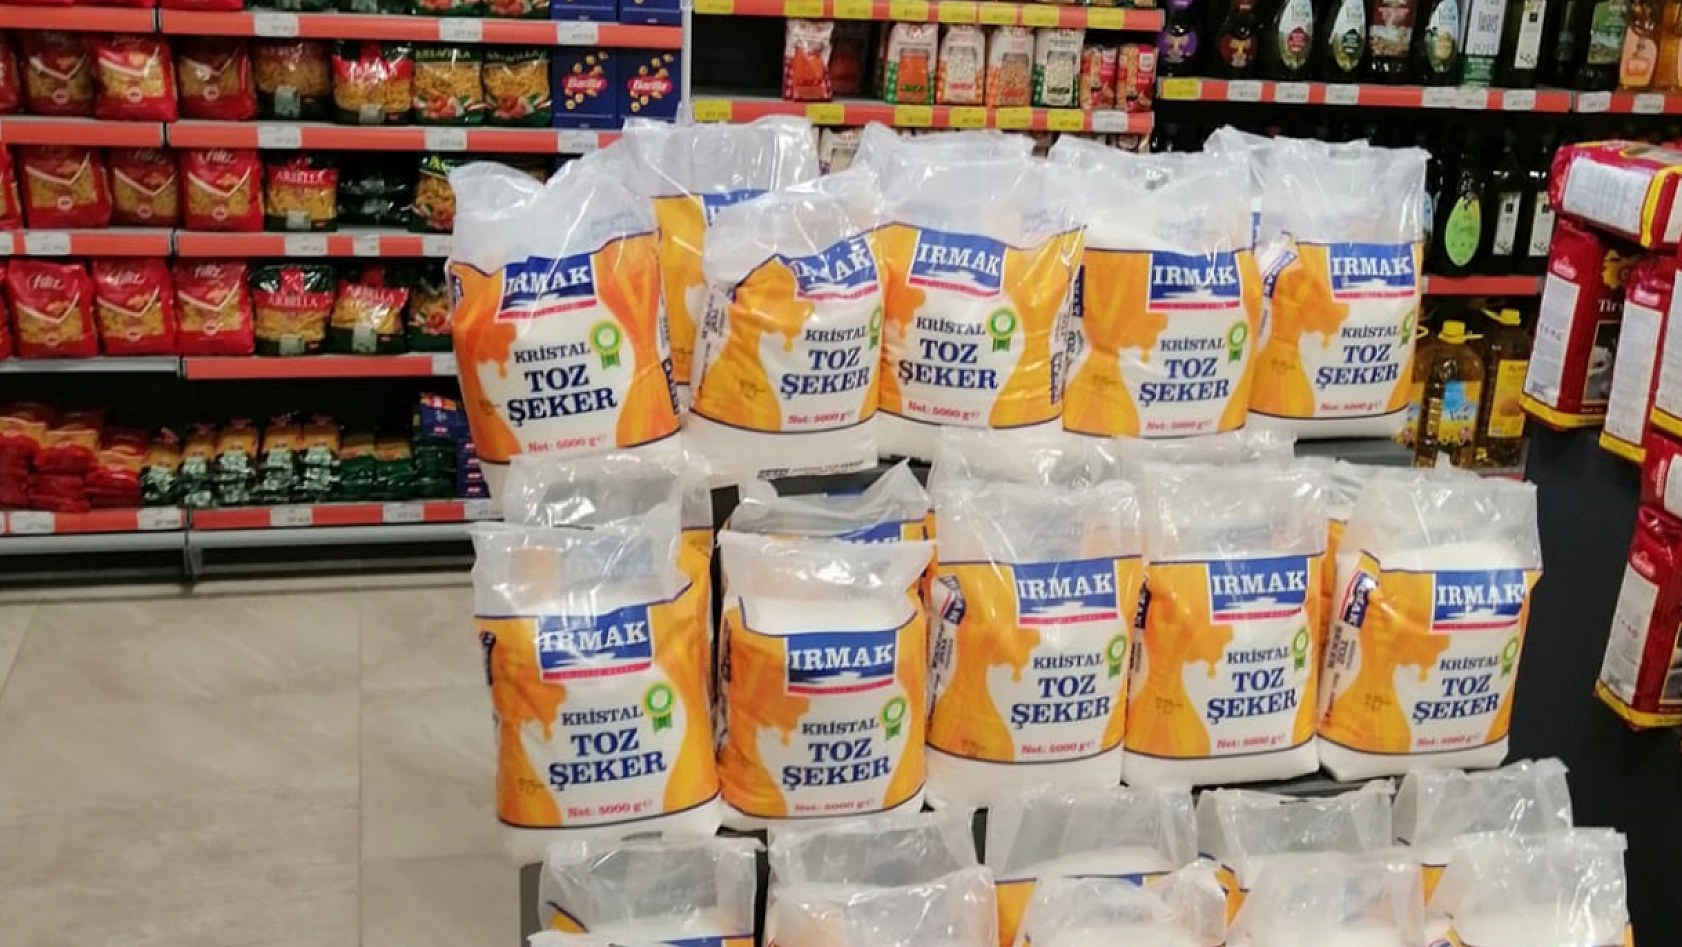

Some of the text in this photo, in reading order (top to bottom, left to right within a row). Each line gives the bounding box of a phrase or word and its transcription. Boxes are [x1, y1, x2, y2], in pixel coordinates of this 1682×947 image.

[916, 242, 1001, 277] IRMAK
[1331, 256, 1413, 277] IRMAK
[1153, 264, 1237, 287] IRMAK
[808, 346, 861, 371] TOZ
[919, 337, 979, 364] TOZ
[1343, 343, 1393, 365] TOZ
[524, 363, 590, 394] TOZ
[898, 359, 998, 390] ŞEKER
[1164, 357, 1218, 379] TOZ
[1315, 362, 1400, 390] ŞEKER
[780, 366, 870, 400] ŞEKER
[1138, 378, 1230, 408] ŞEKER
[506, 387, 618, 428] ŞEKER
[1018, 573, 1114, 600] IRMAK
[1211, 570, 1306, 596] IRMAK
[1437, 582, 1526, 608] IRMAK
[789, 643, 896, 670] IRMAK
[1037, 673, 1097, 699] TOZ
[1231, 666, 1285, 693] TOZ
[1441, 673, 1493, 698] TOZ
[1010, 696, 1111, 730] ŞEKER
[1206, 688, 1298, 726] ŞEKER
[1412, 692, 1499, 726] ŞEKER
[571, 728, 640, 757] TOZ
[808, 736, 873, 763] TOZ
[548, 750, 668, 792] ŞEKER
[782, 756, 892, 792] ŞEKER
